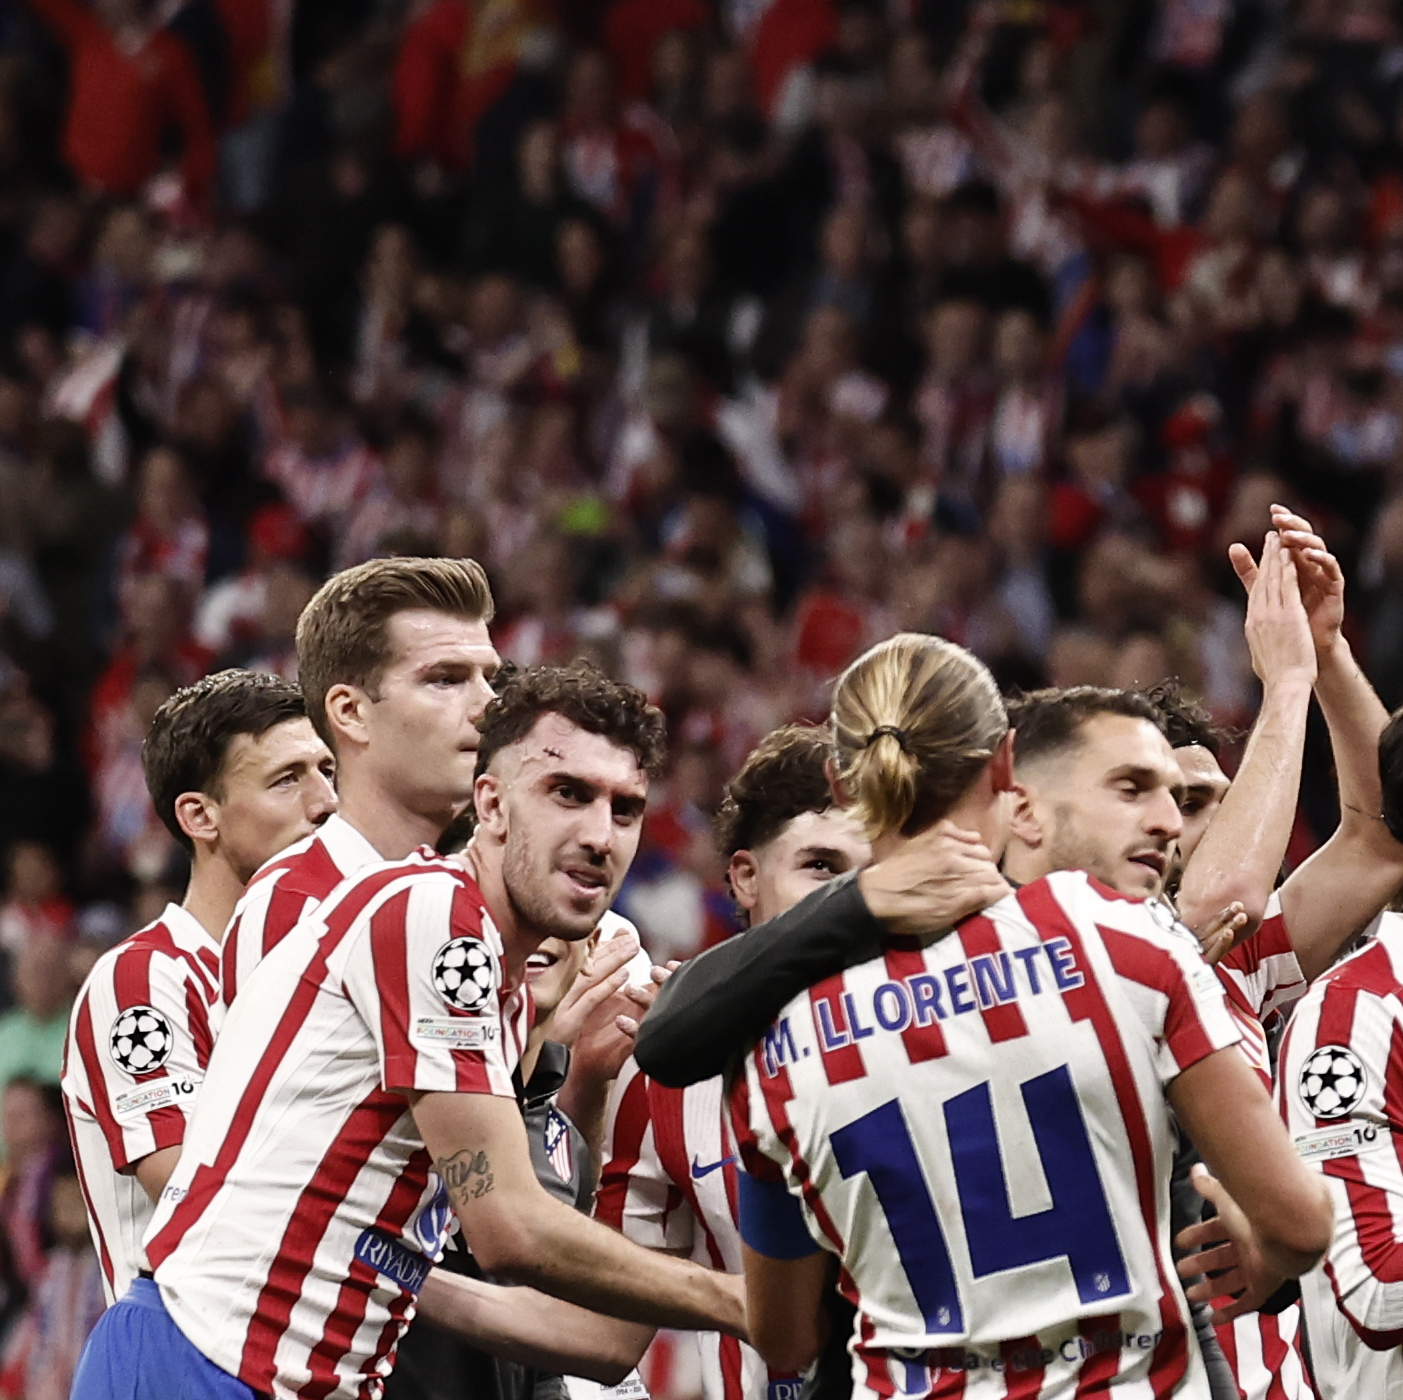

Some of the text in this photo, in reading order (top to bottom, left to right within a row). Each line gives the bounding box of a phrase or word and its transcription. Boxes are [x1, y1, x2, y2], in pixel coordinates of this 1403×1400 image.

[763, 938, 1085, 1077] M. LLORENTE
[360, 1234, 423, 1288] RIYADH
[829, 1064, 1133, 1334] 14
